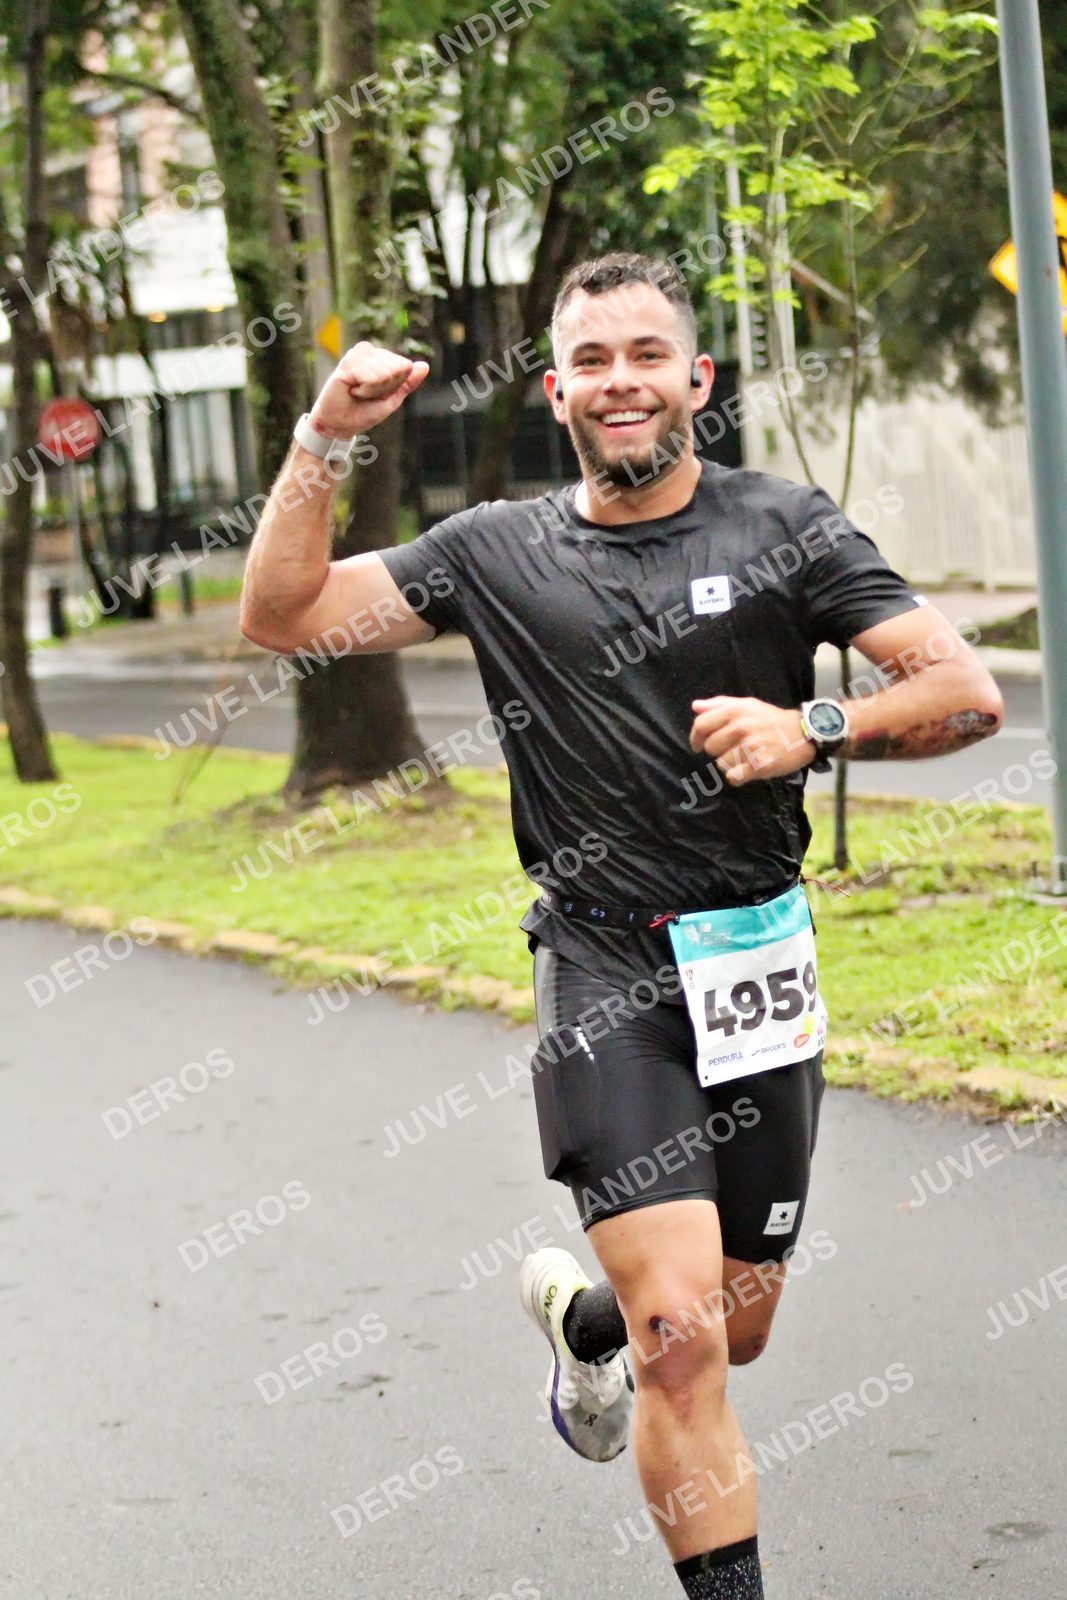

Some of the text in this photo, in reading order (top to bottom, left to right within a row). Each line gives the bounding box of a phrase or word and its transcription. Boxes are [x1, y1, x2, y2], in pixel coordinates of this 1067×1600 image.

[704, 960, 816, 1038] 4959
[708, 1042, 787, 1067] PERDURA BROOKS
